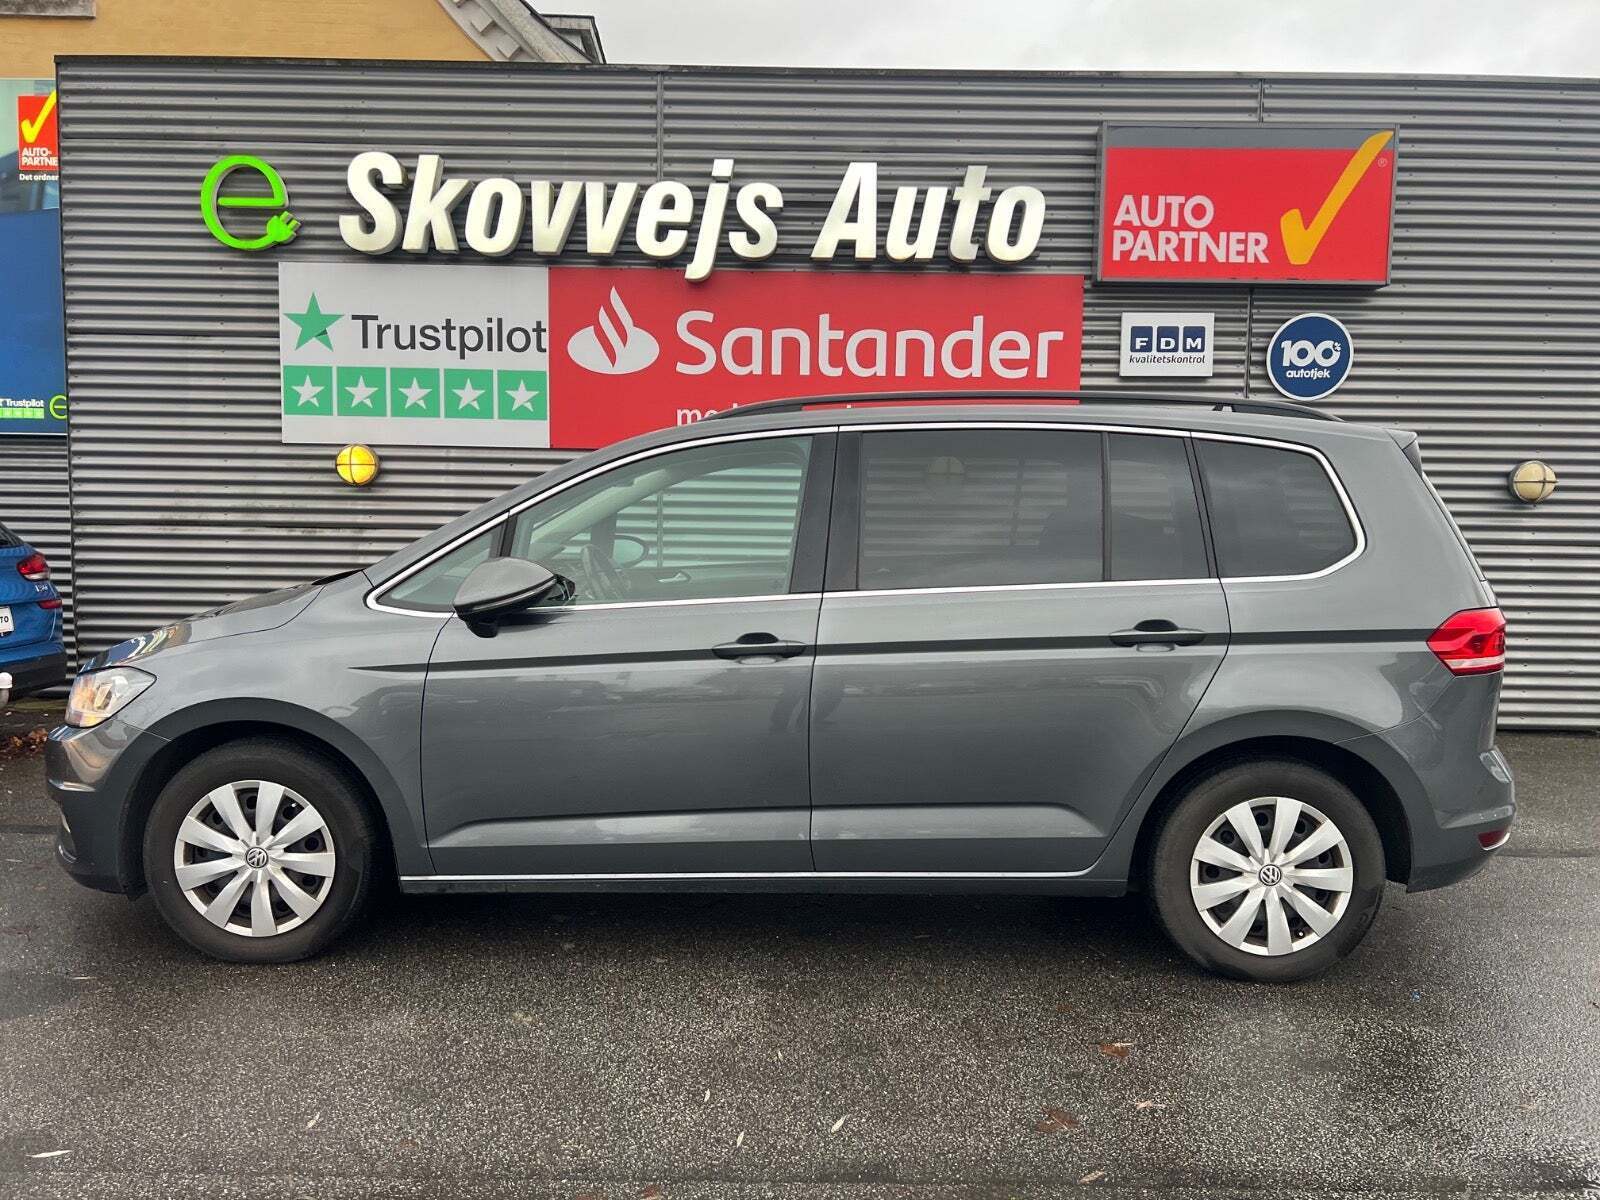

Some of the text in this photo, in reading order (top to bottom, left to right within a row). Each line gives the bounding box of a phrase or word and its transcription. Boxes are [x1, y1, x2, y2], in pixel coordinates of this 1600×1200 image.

[19, 173, 33, 181] Det
[339, 151, 1047, 282] Skovvejs Auto
[1113, 195, 1215, 229] AUTO
[1111, 230, 1270, 264] PARTNER
[351, 314, 548, 360] Trustpilot
[675, 309, 1065, 379] Santander
[1135, 337, 1202, 350] FDM
[1129, 354, 1206, 364] kvalitetskontrol
[1286, 367, 1331, 380] autotjek
[6, 398, 45, 409] Trustpilot
